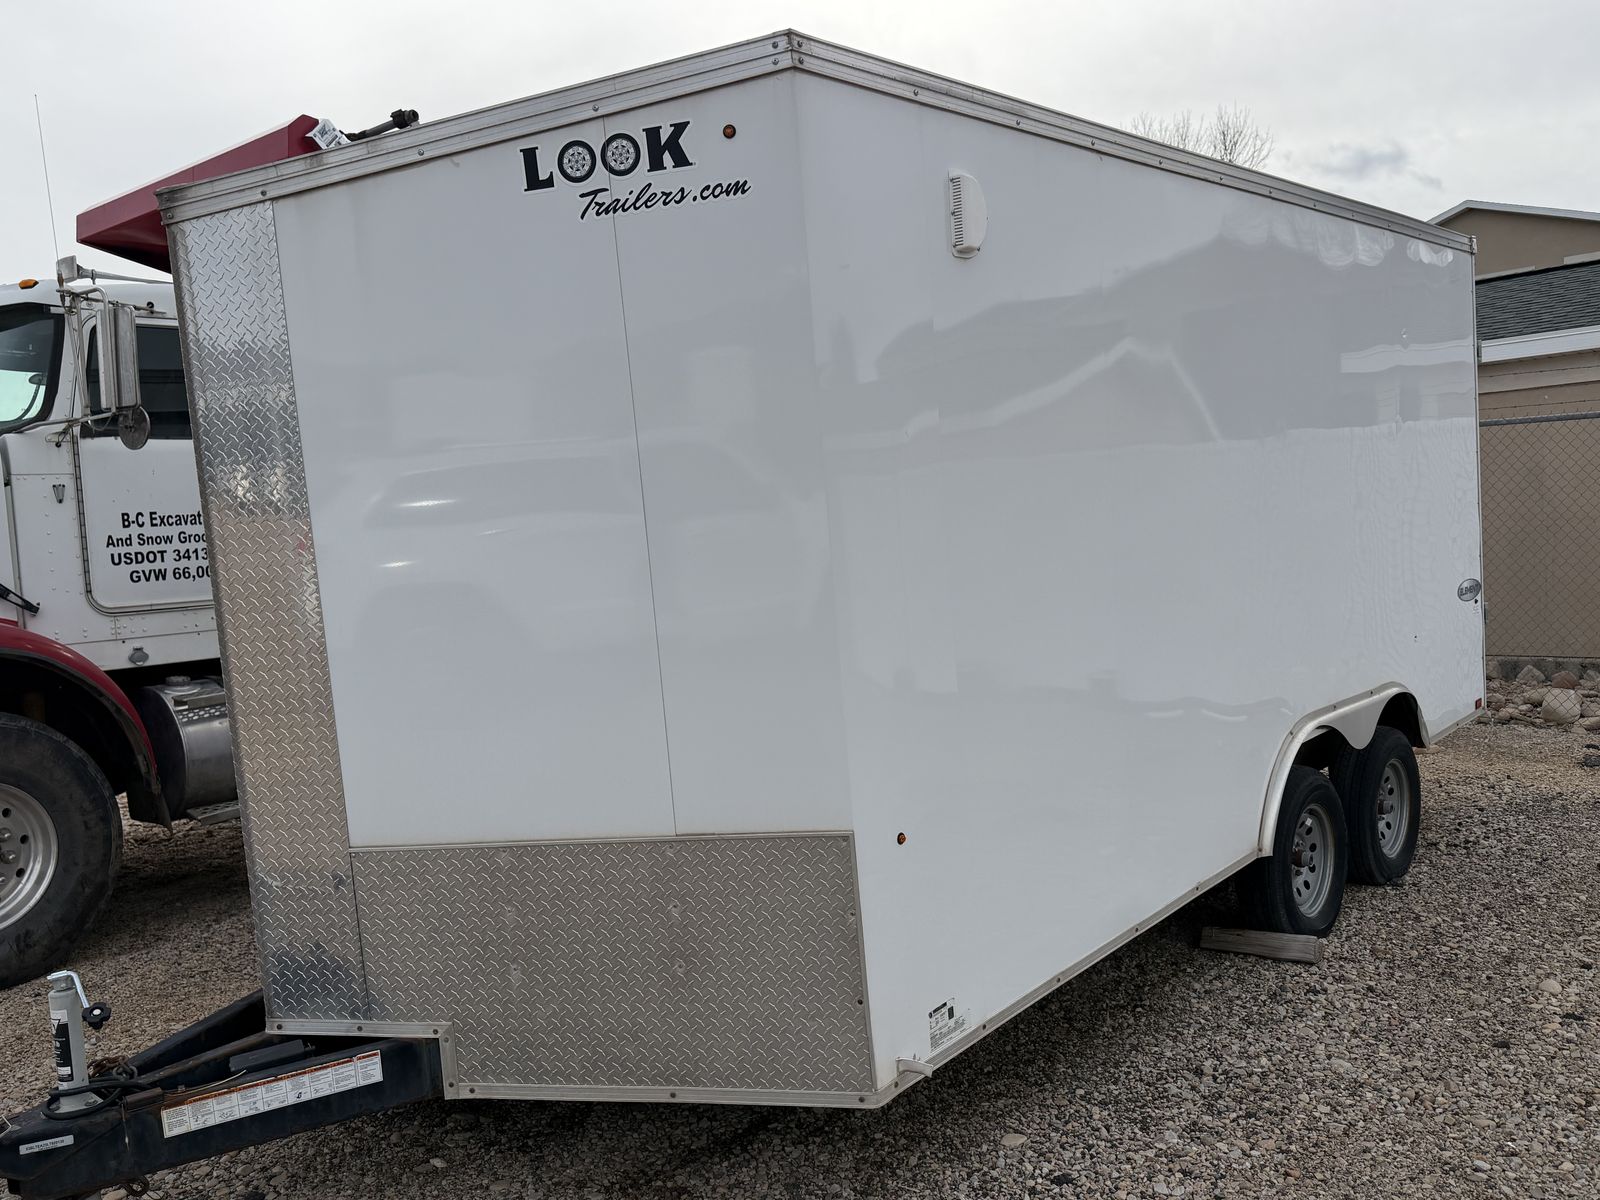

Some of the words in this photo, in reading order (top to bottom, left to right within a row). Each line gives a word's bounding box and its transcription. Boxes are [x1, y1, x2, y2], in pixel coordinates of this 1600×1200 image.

[520, 121, 693, 191] LOOK
[579, 178, 751, 220] Trailers.com
[121, 512, 145, 528] B-C
[149, 511, 203, 527] Excavat
[106, 534, 133, 548] And
[137, 533, 173, 546] Snow
[110, 550, 167, 566] USDOT
[172, 548, 207, 561] 3413
[129, 568, 167, 583] GVW
